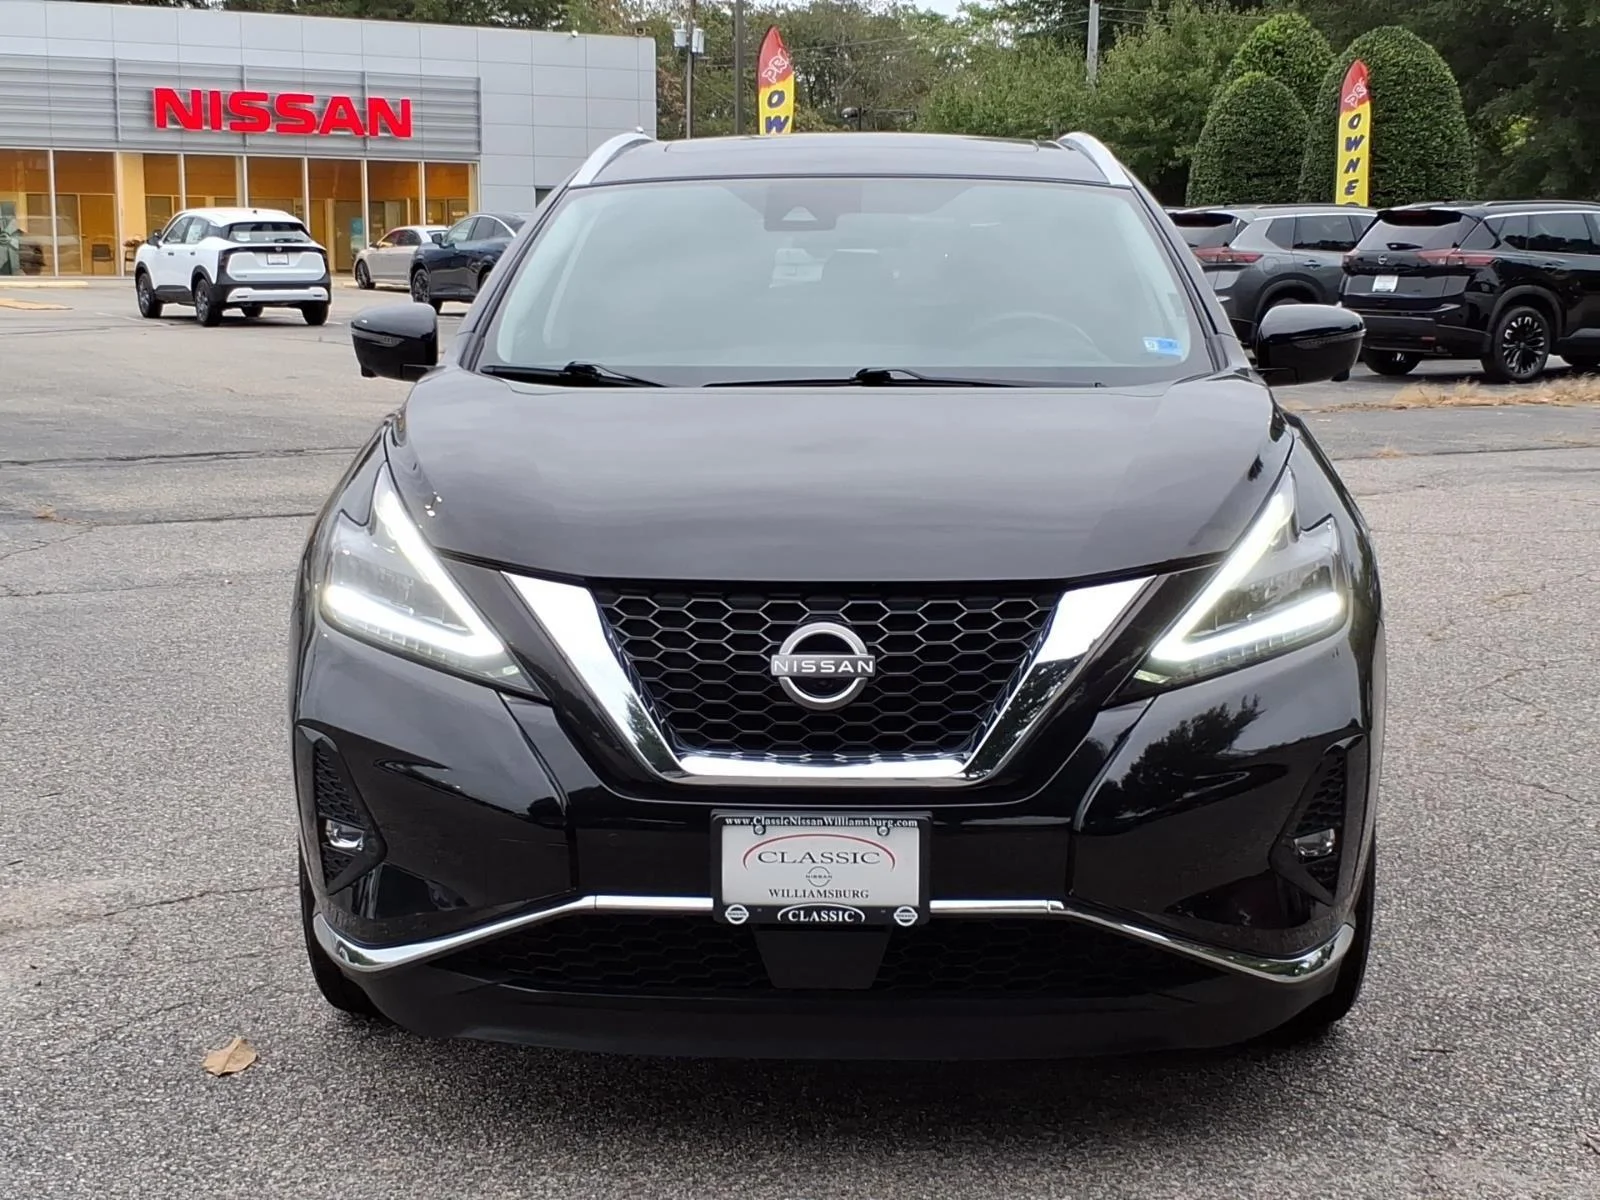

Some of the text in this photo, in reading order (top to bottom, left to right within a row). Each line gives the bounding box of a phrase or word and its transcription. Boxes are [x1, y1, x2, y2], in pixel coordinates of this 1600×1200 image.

[154, 87, 413, 138] NISSAN
[1343, 113, 1365, 206] OWNE
[774, 660, 873, 673] NISSAN
[725, 816, 918, 828] www.ClassicNissanWilliamsburg.com
[758, 851, 881, 864] CLASSIC
[769, 888, 870, 899] WILLIAMSBURG
[788, 910, 855, 922] CLASSIC
